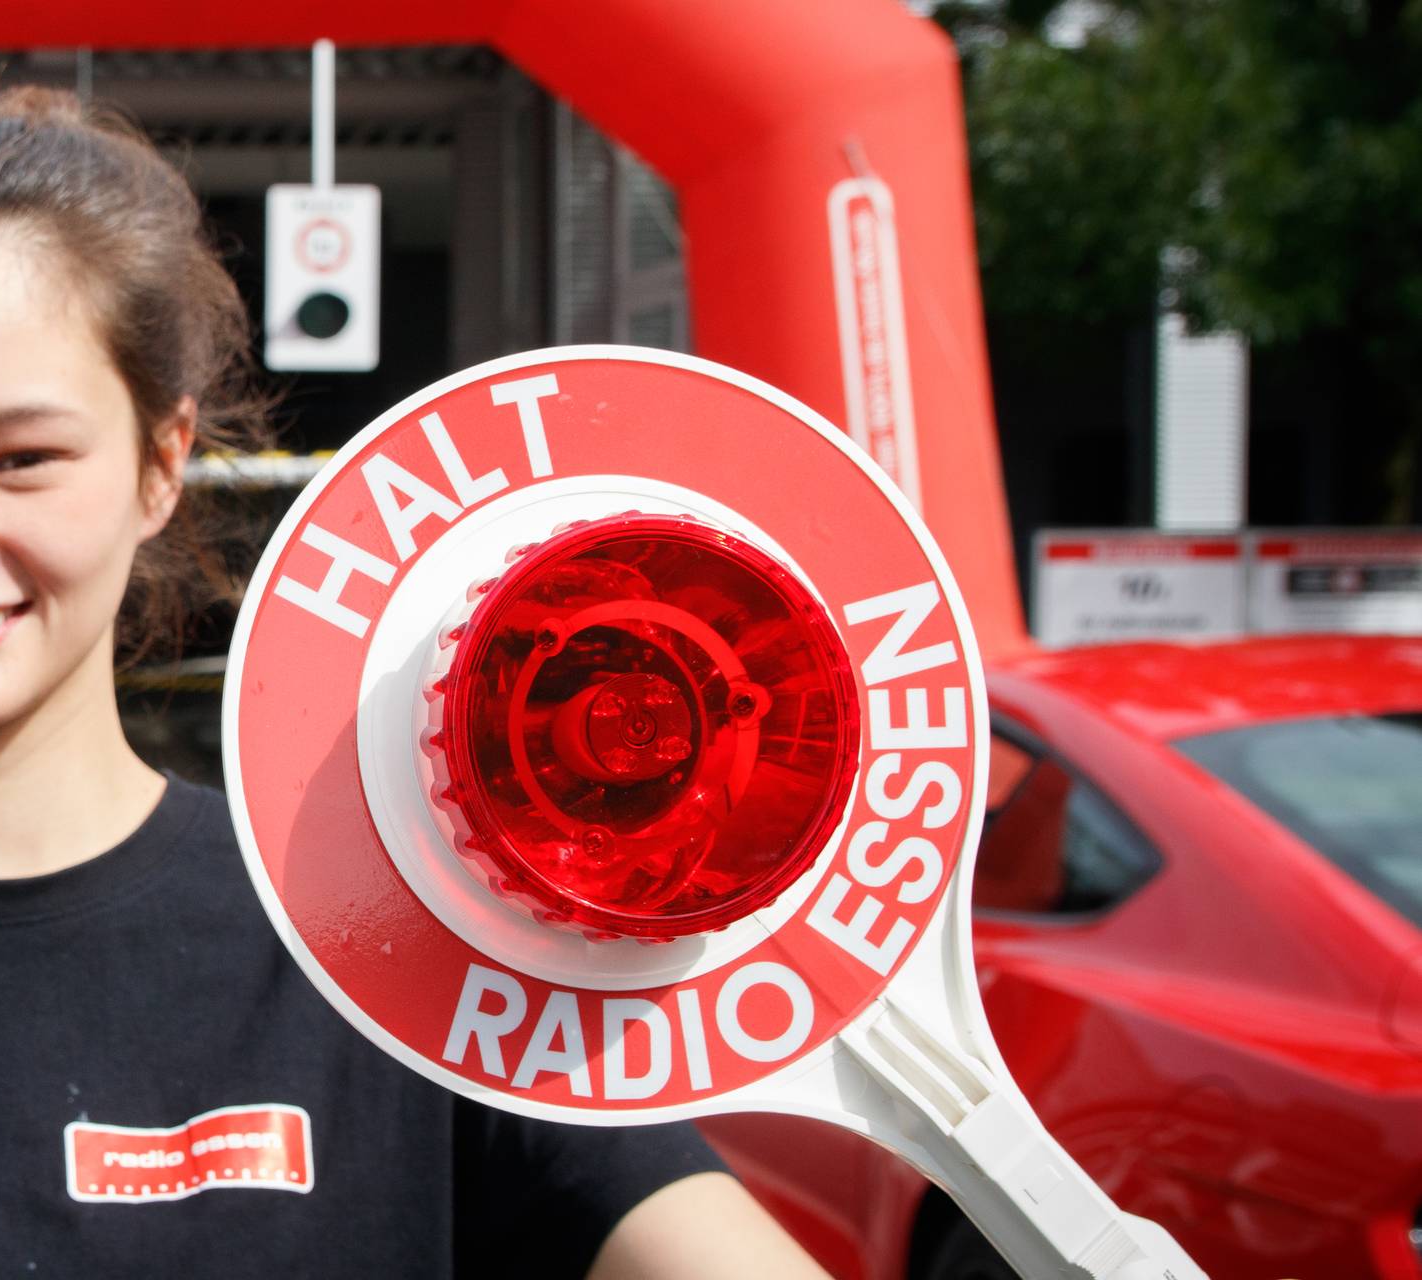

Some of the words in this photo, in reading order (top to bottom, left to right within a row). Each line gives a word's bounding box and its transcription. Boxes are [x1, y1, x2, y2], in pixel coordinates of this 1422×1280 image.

[274, 373, 559, 639] HALT
[442, 961, 814, 1100] RADIO
[805, 580, 967, 977] ESSEN
[104, 1149, 185, 1168] radio
[191, 1132, 282, 1156] essen
